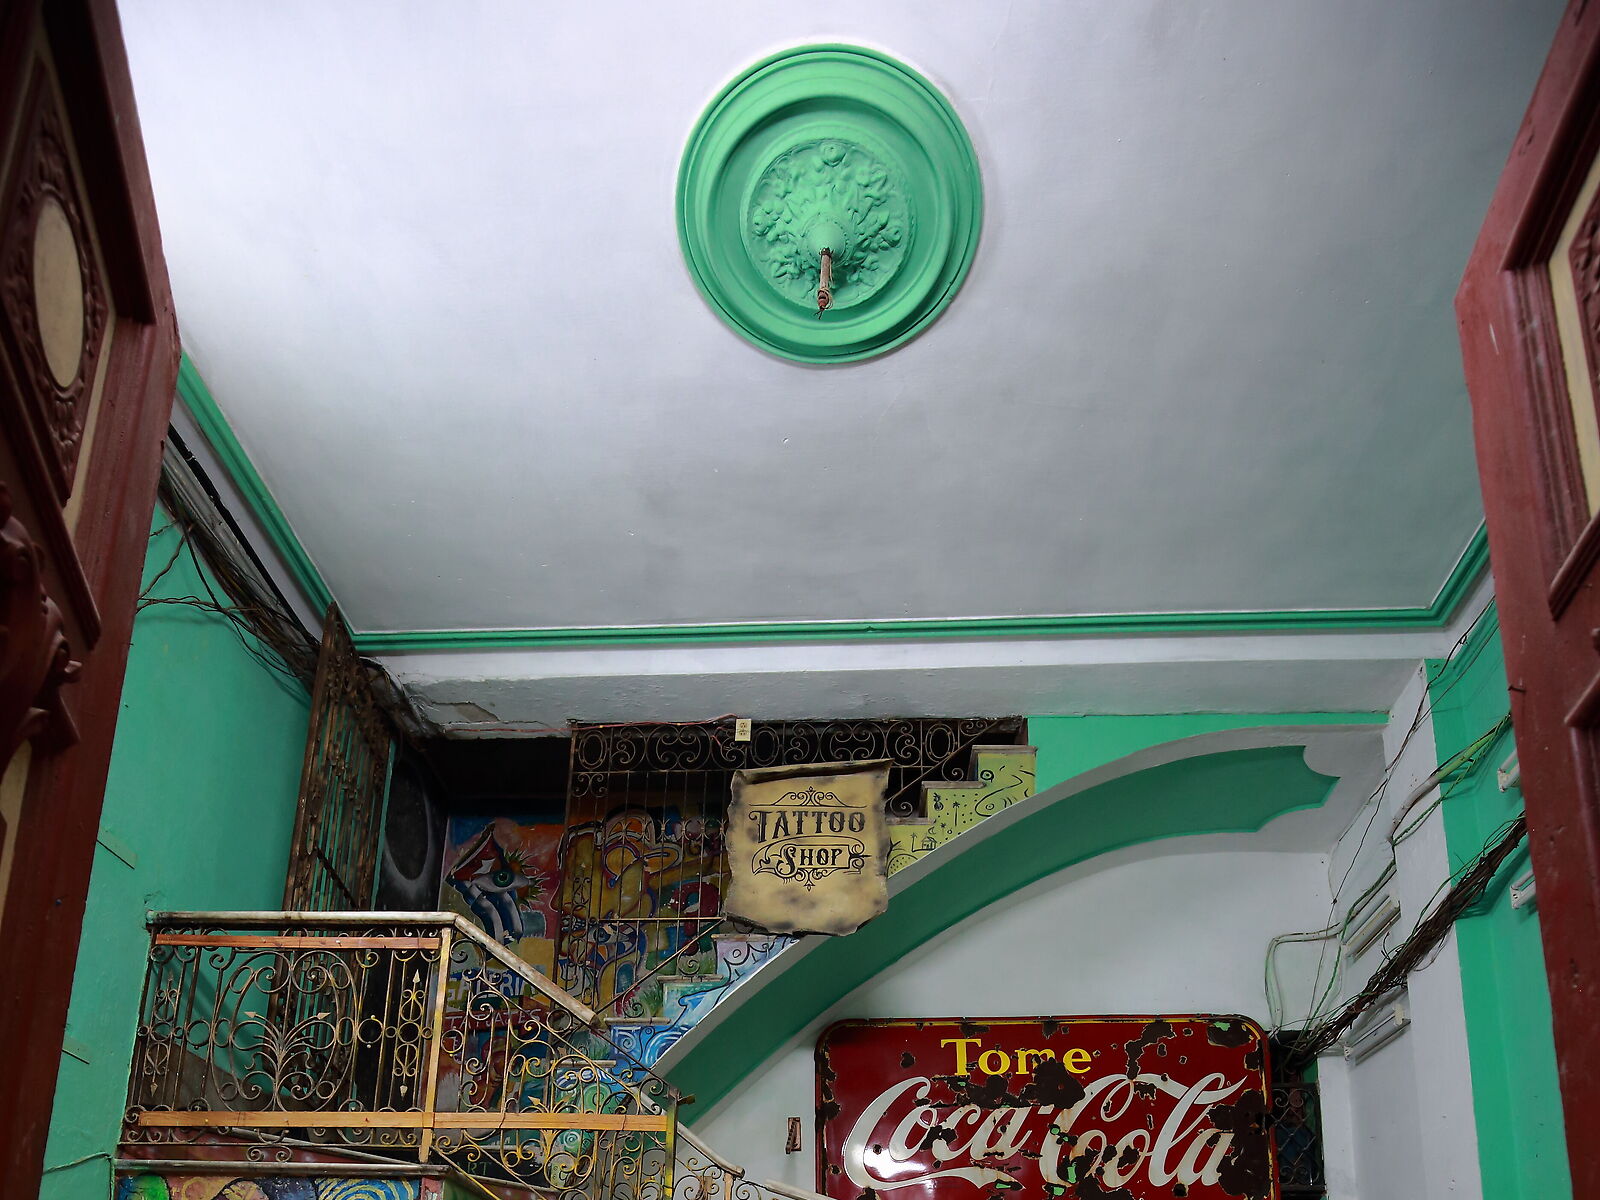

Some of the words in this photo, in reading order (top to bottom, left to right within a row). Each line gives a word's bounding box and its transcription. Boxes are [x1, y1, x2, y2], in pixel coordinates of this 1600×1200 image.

[749, 810, 866, 843] TATTOO
[776, 845, 843, 875] SHOP
[844, 1072, 1248, 1190] Coca-Cola
